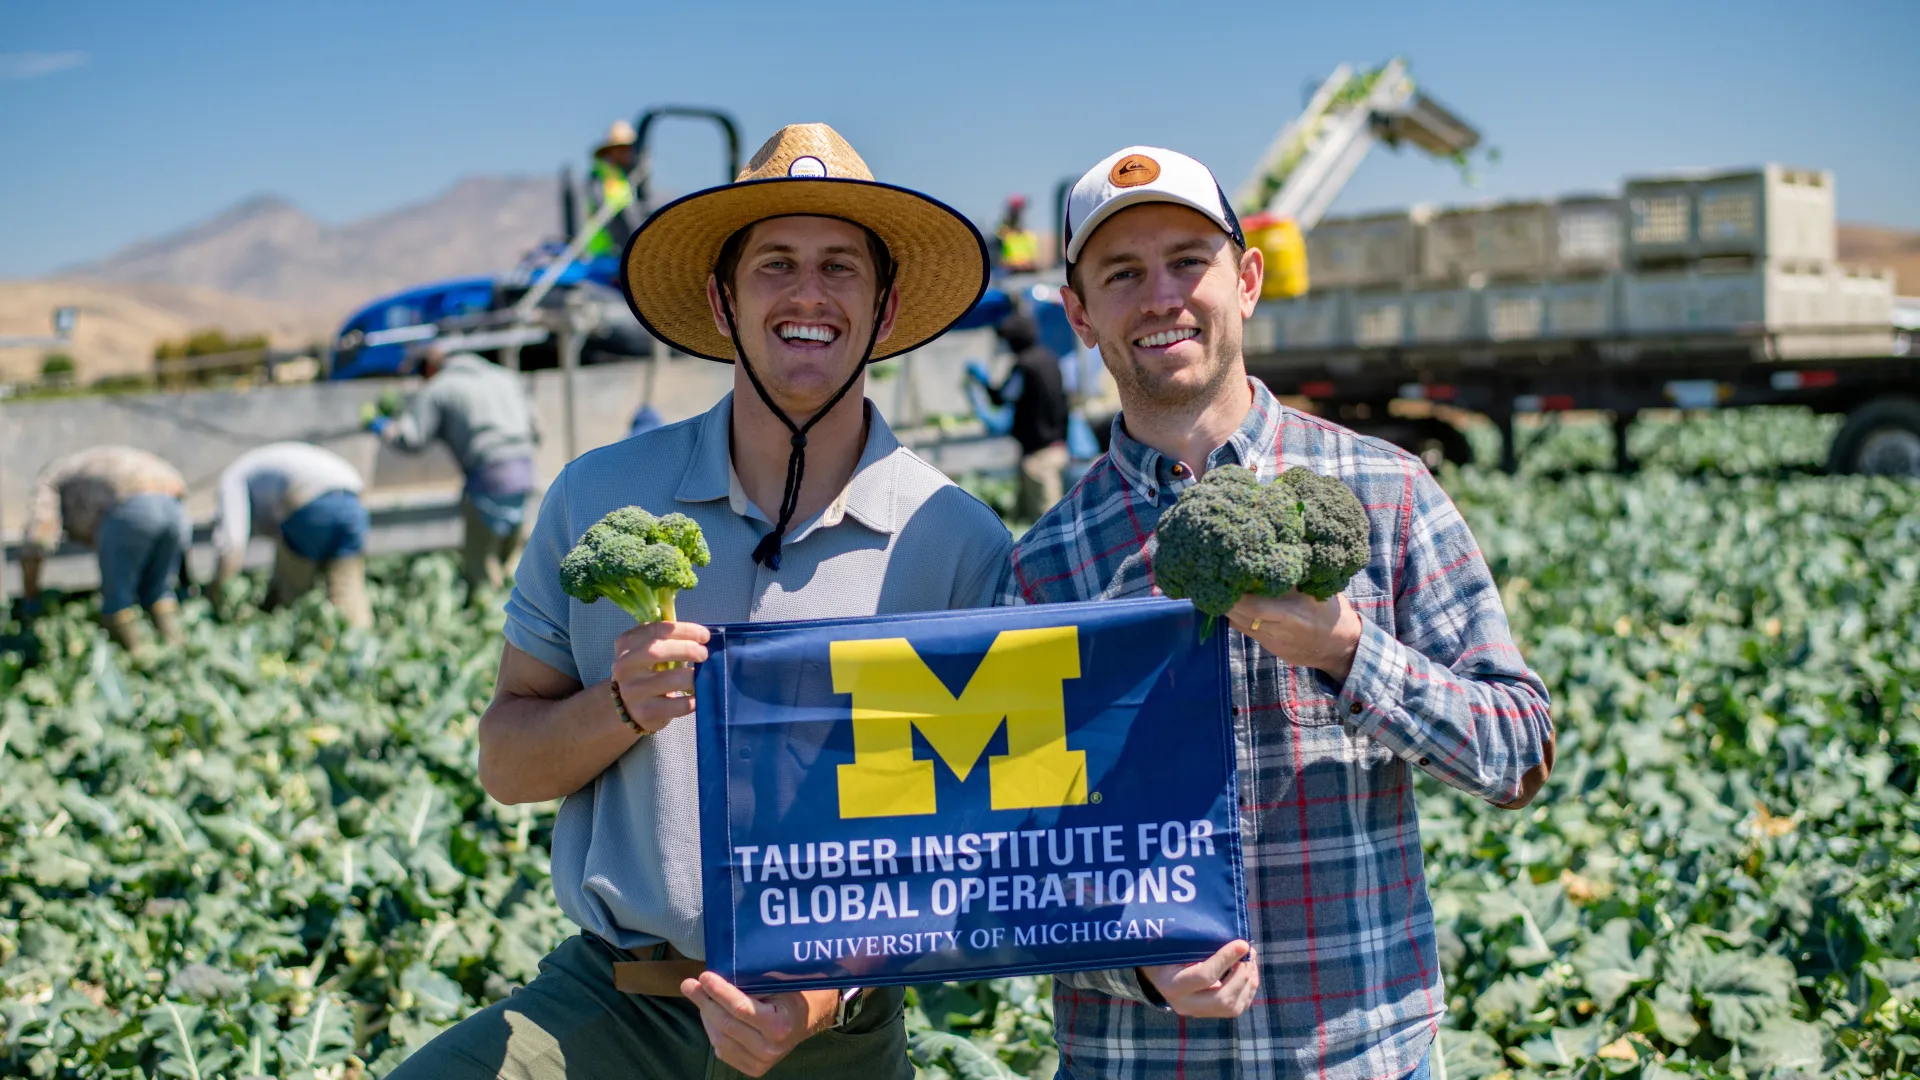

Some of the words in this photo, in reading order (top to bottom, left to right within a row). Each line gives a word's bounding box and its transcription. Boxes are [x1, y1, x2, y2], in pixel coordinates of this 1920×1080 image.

[830, 625, 1088, 819] M
[734, 838, 899, 883] TAUBER
[911, 825, 1125, 873] INSTITUTE
[1137, 819, 1215, 860] FOR
[759, 881, 919, 926] GLOBAL
[931, 864, 1197, 917] OPERATIONS
[793, 931, 962, 962] UNIVERSITY
[969, 927, 1006, 950] OF
